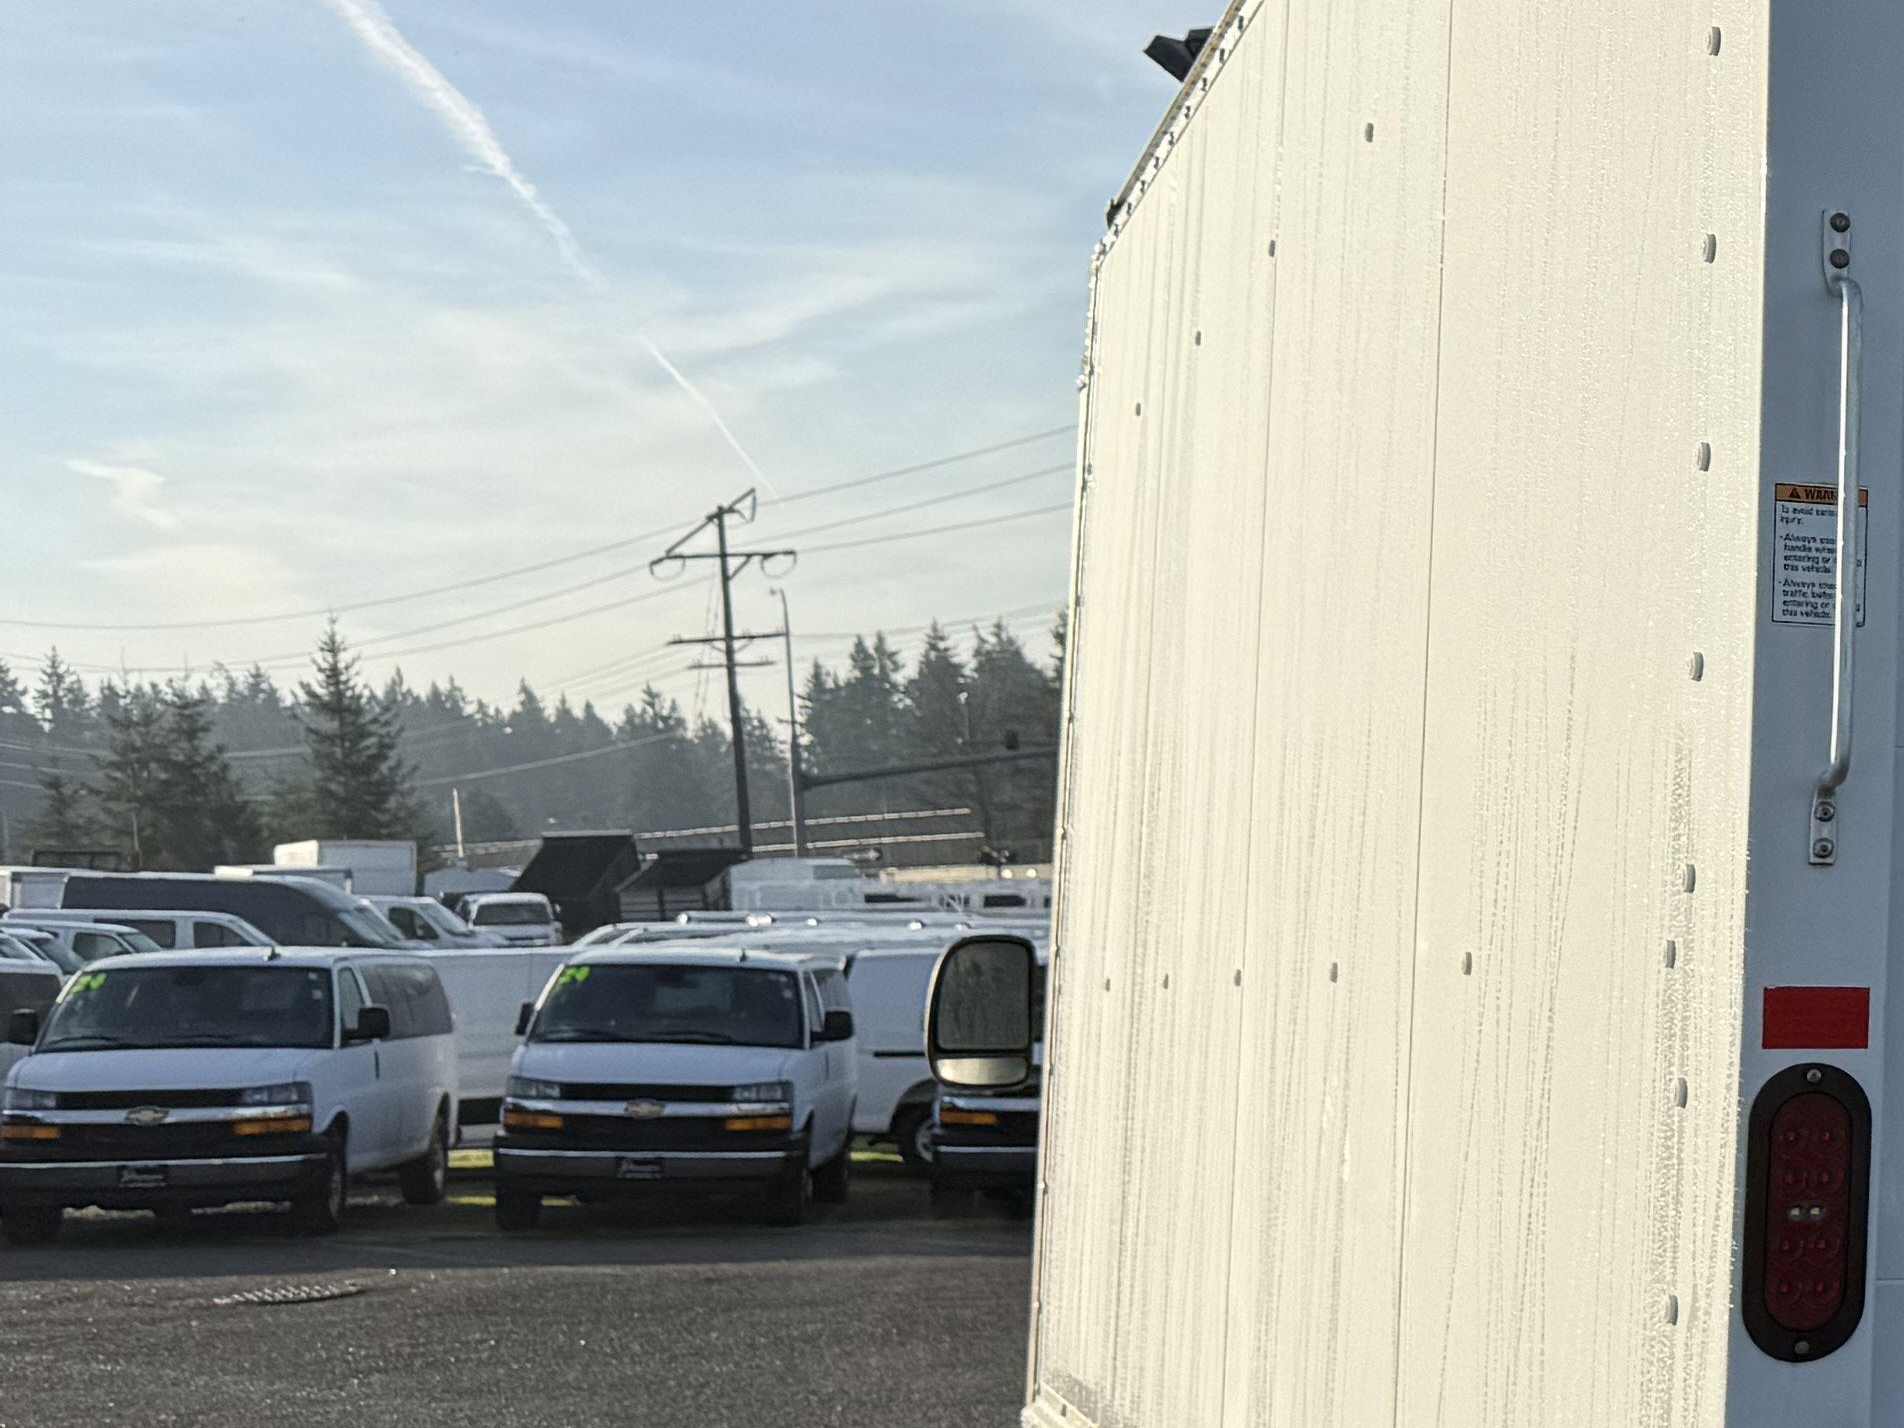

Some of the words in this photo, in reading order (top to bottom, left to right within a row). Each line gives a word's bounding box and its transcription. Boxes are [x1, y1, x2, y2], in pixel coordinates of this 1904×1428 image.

[1783, 533, 1817, 544] Always
[1784, 543, 1812, 552] handle
[1784, 555, 1819, 564] entering
[1782, 578, 1816, 589] Always
[1782, 589, 1808, 598] traffic
[1782, 600, 1819, 609] entering
